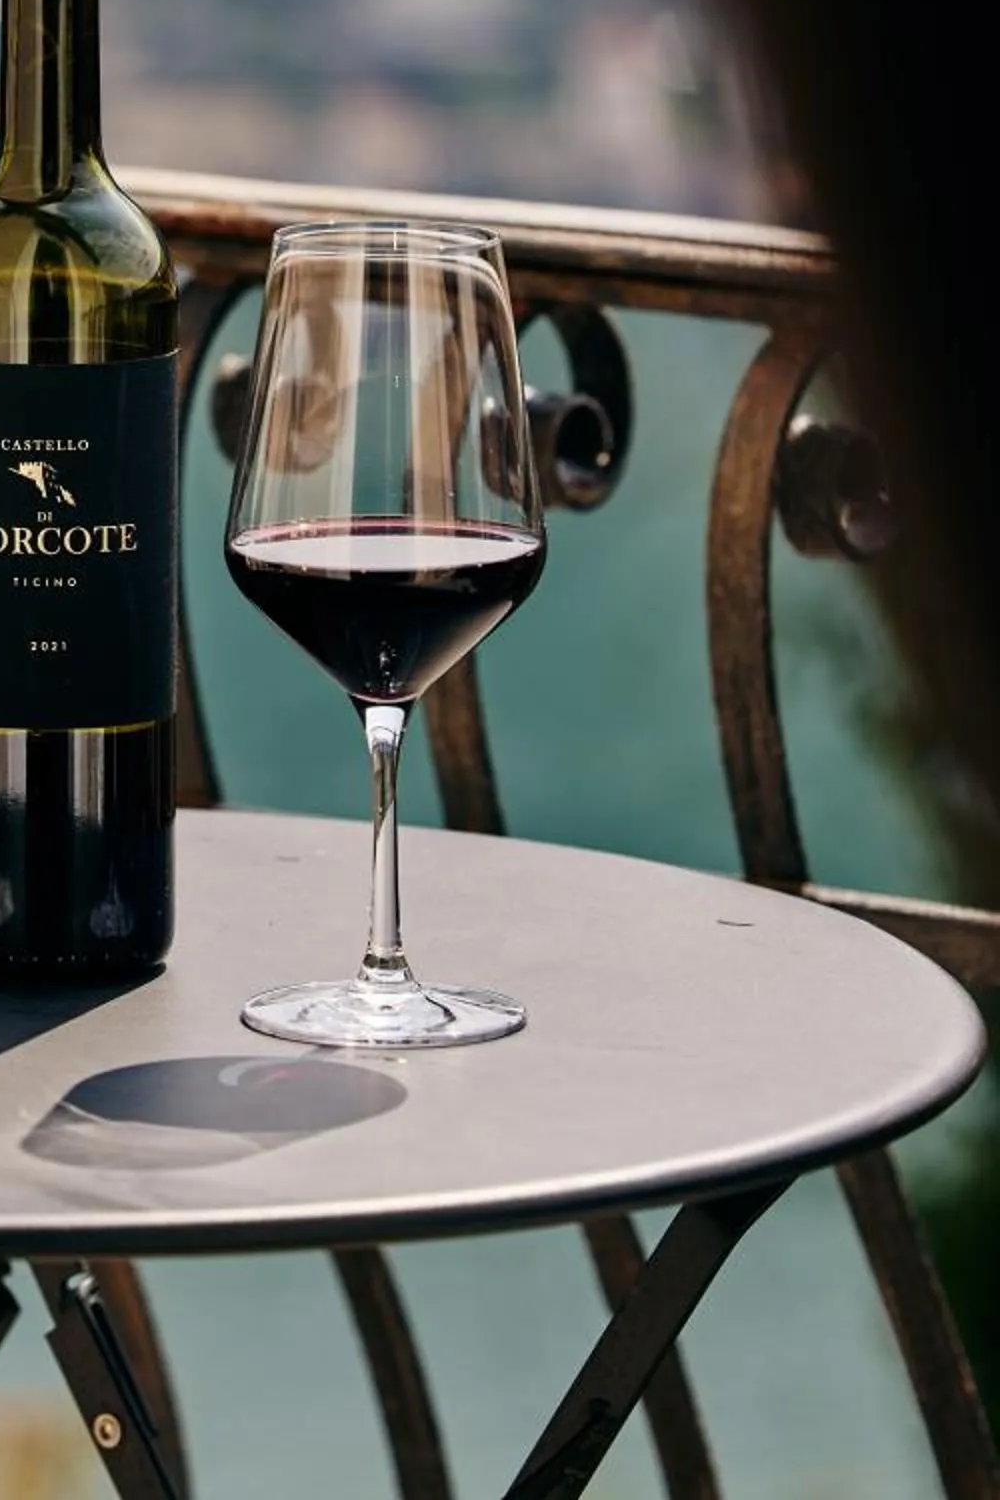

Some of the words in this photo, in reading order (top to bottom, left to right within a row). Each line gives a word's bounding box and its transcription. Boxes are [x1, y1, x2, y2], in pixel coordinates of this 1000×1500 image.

[0, 438, 90, 452] CASTELLO
[36, 511, 53, 523] DI
[12, 576, 78, 588] TICINO
[30, 640, 68, 652] 2021
